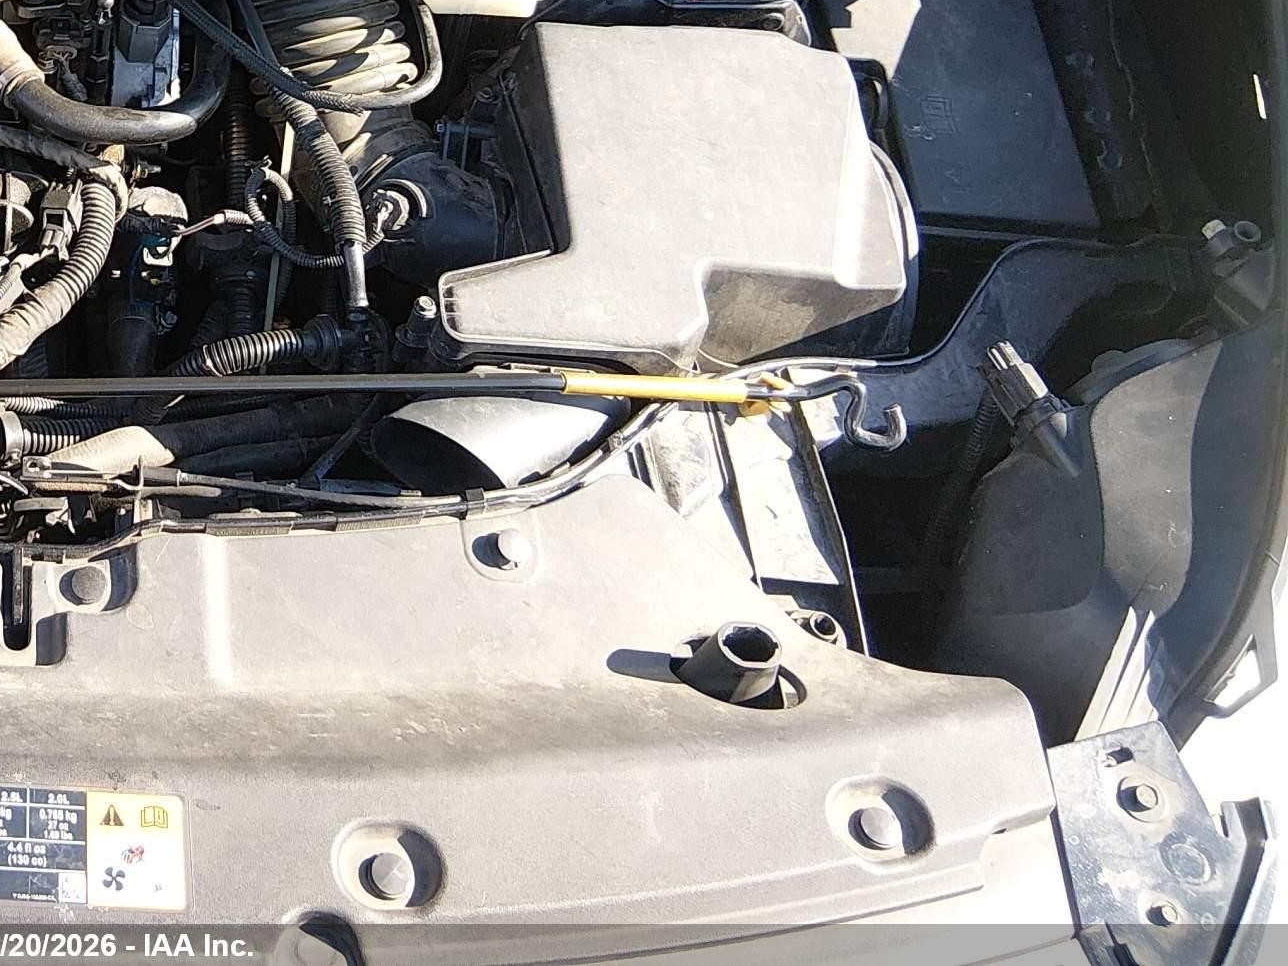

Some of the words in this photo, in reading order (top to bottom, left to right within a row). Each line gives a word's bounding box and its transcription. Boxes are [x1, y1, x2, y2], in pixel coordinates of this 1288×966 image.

[47, 792, 70, 805] 2.0L
[0, 806, 12, 821] kg
[65, 809, 78, 825] kg
[47, 820, 58, 830] 27
[7, 841, 23, 853] 4.4
[24, 842, 32, 853] fl
[33, 844, 47, 855] oz
[7, 854, 30, 867] (130
